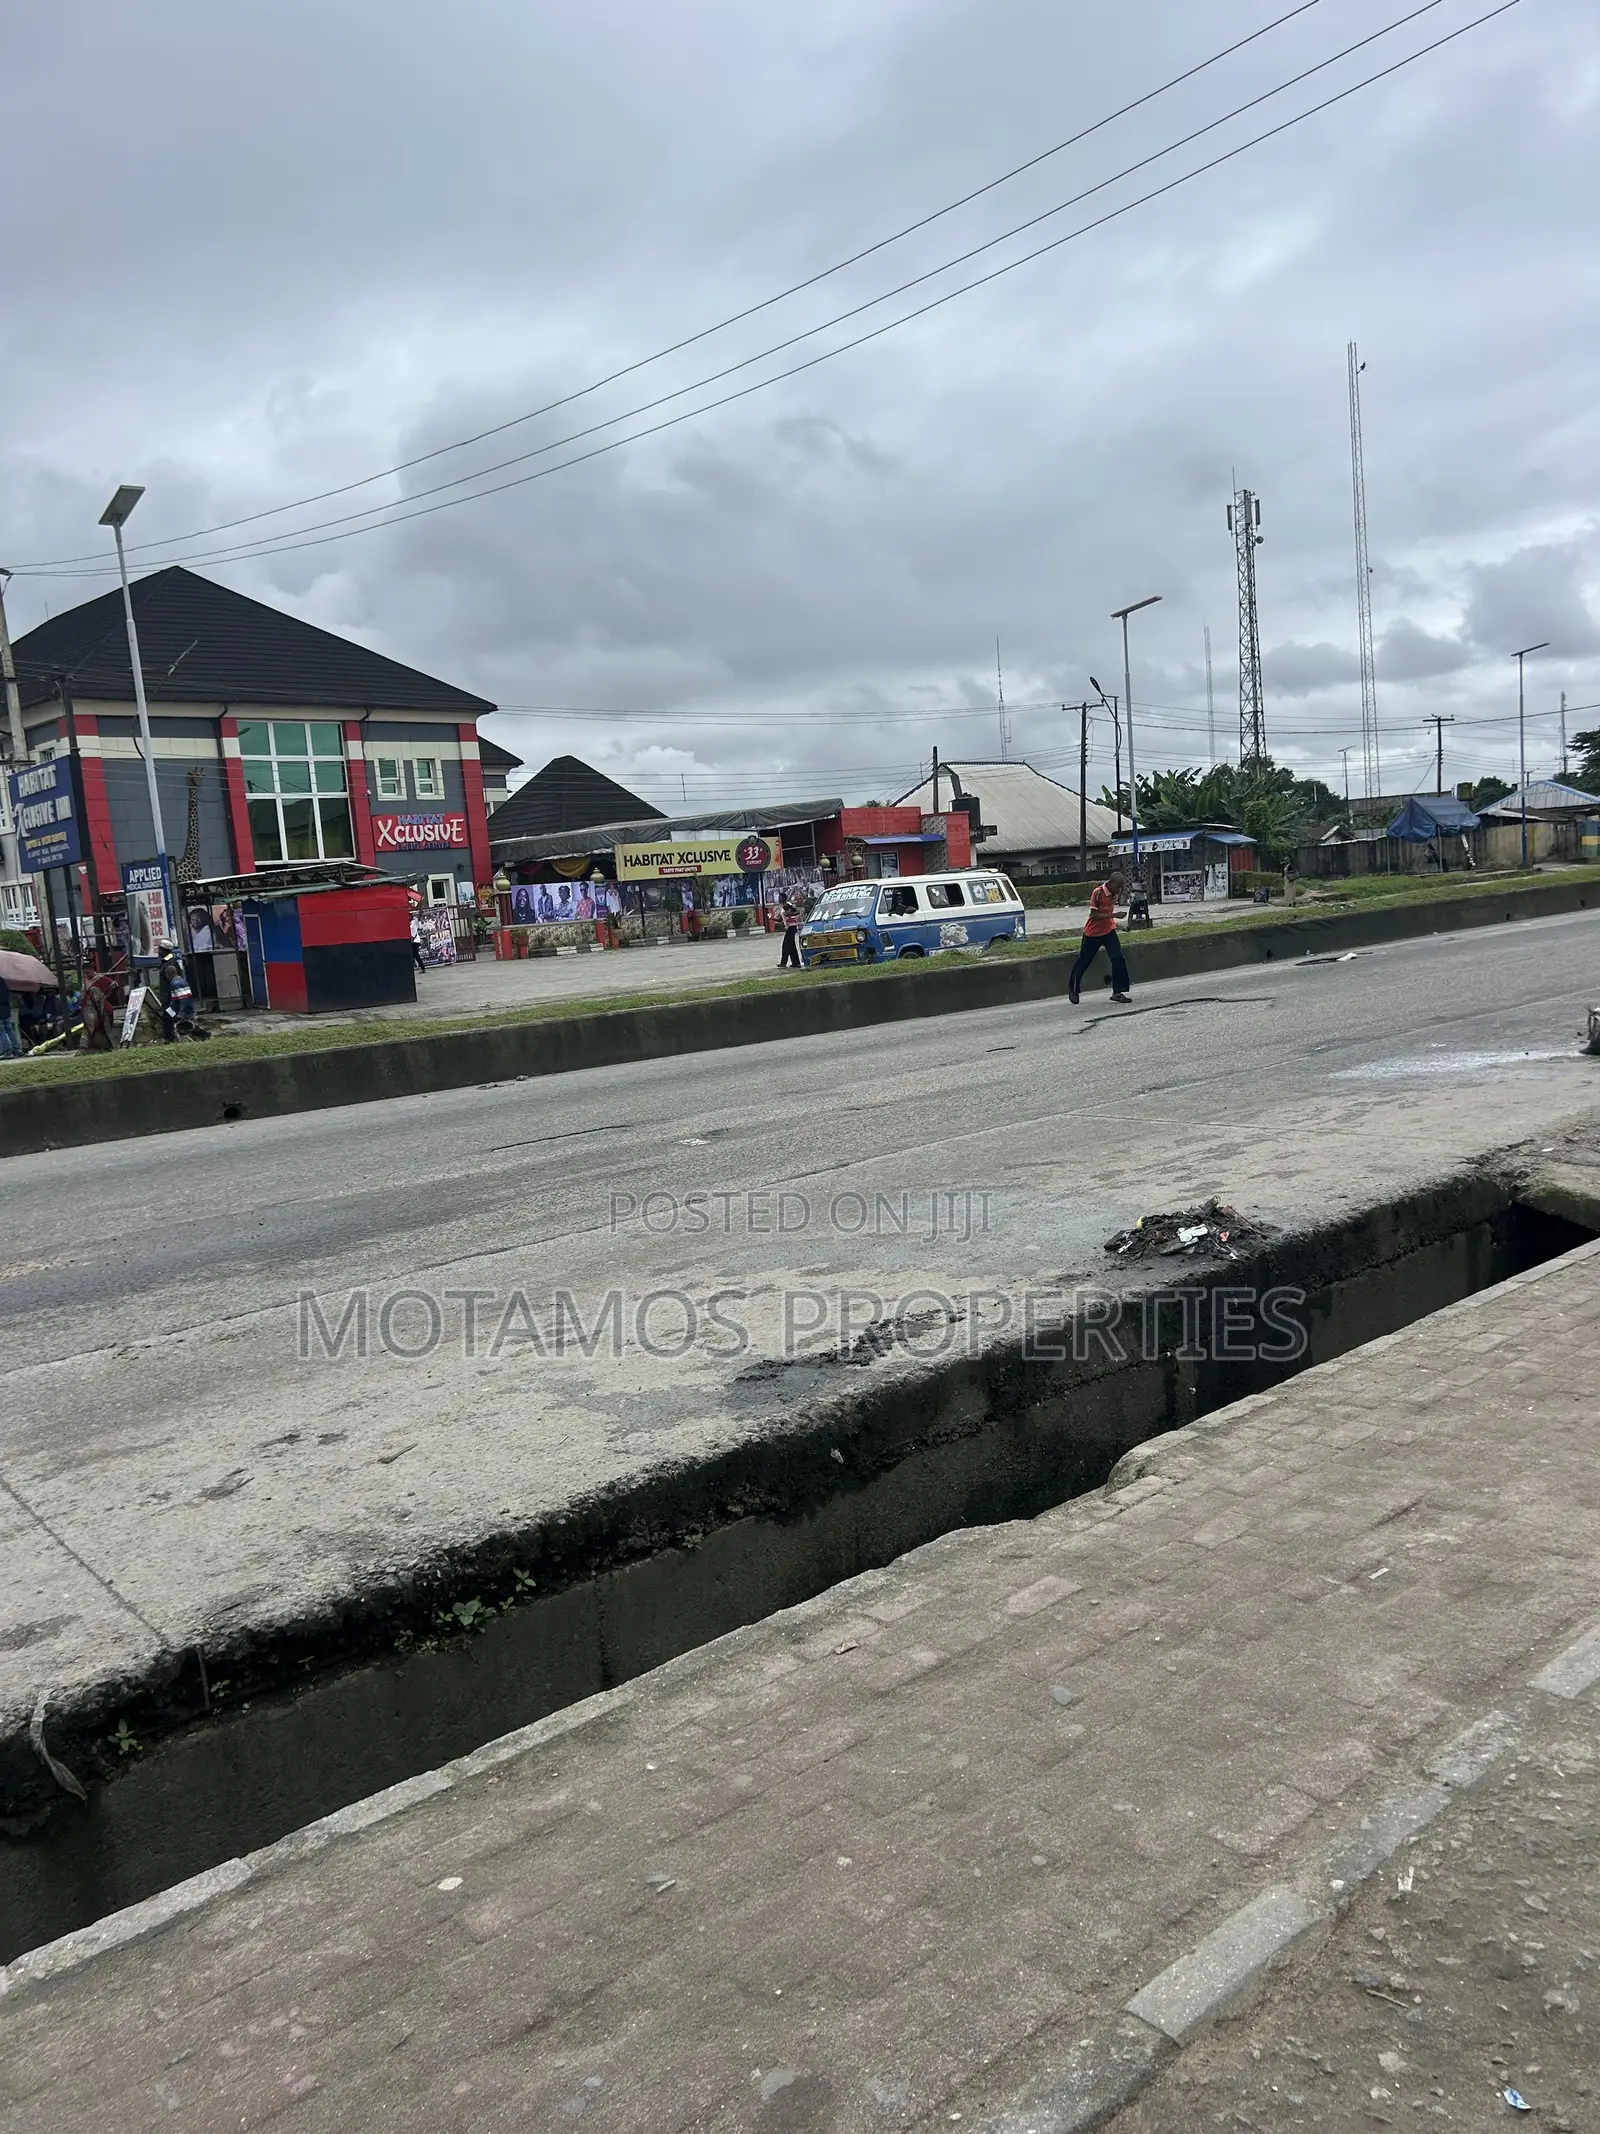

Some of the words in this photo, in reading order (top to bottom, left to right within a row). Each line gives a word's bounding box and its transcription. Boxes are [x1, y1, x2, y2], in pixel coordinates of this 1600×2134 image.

[18, 764, 57, 798] HABITAT
[397, 813, 445, 825] HABITAT
[377, 818, 464, 847] XCLUSIVE
[623, 853, 675, 867] HABITAT
[677, 849, 731, 864] XCLUSIVE
[129, 866, 162, 883] APPLIED
